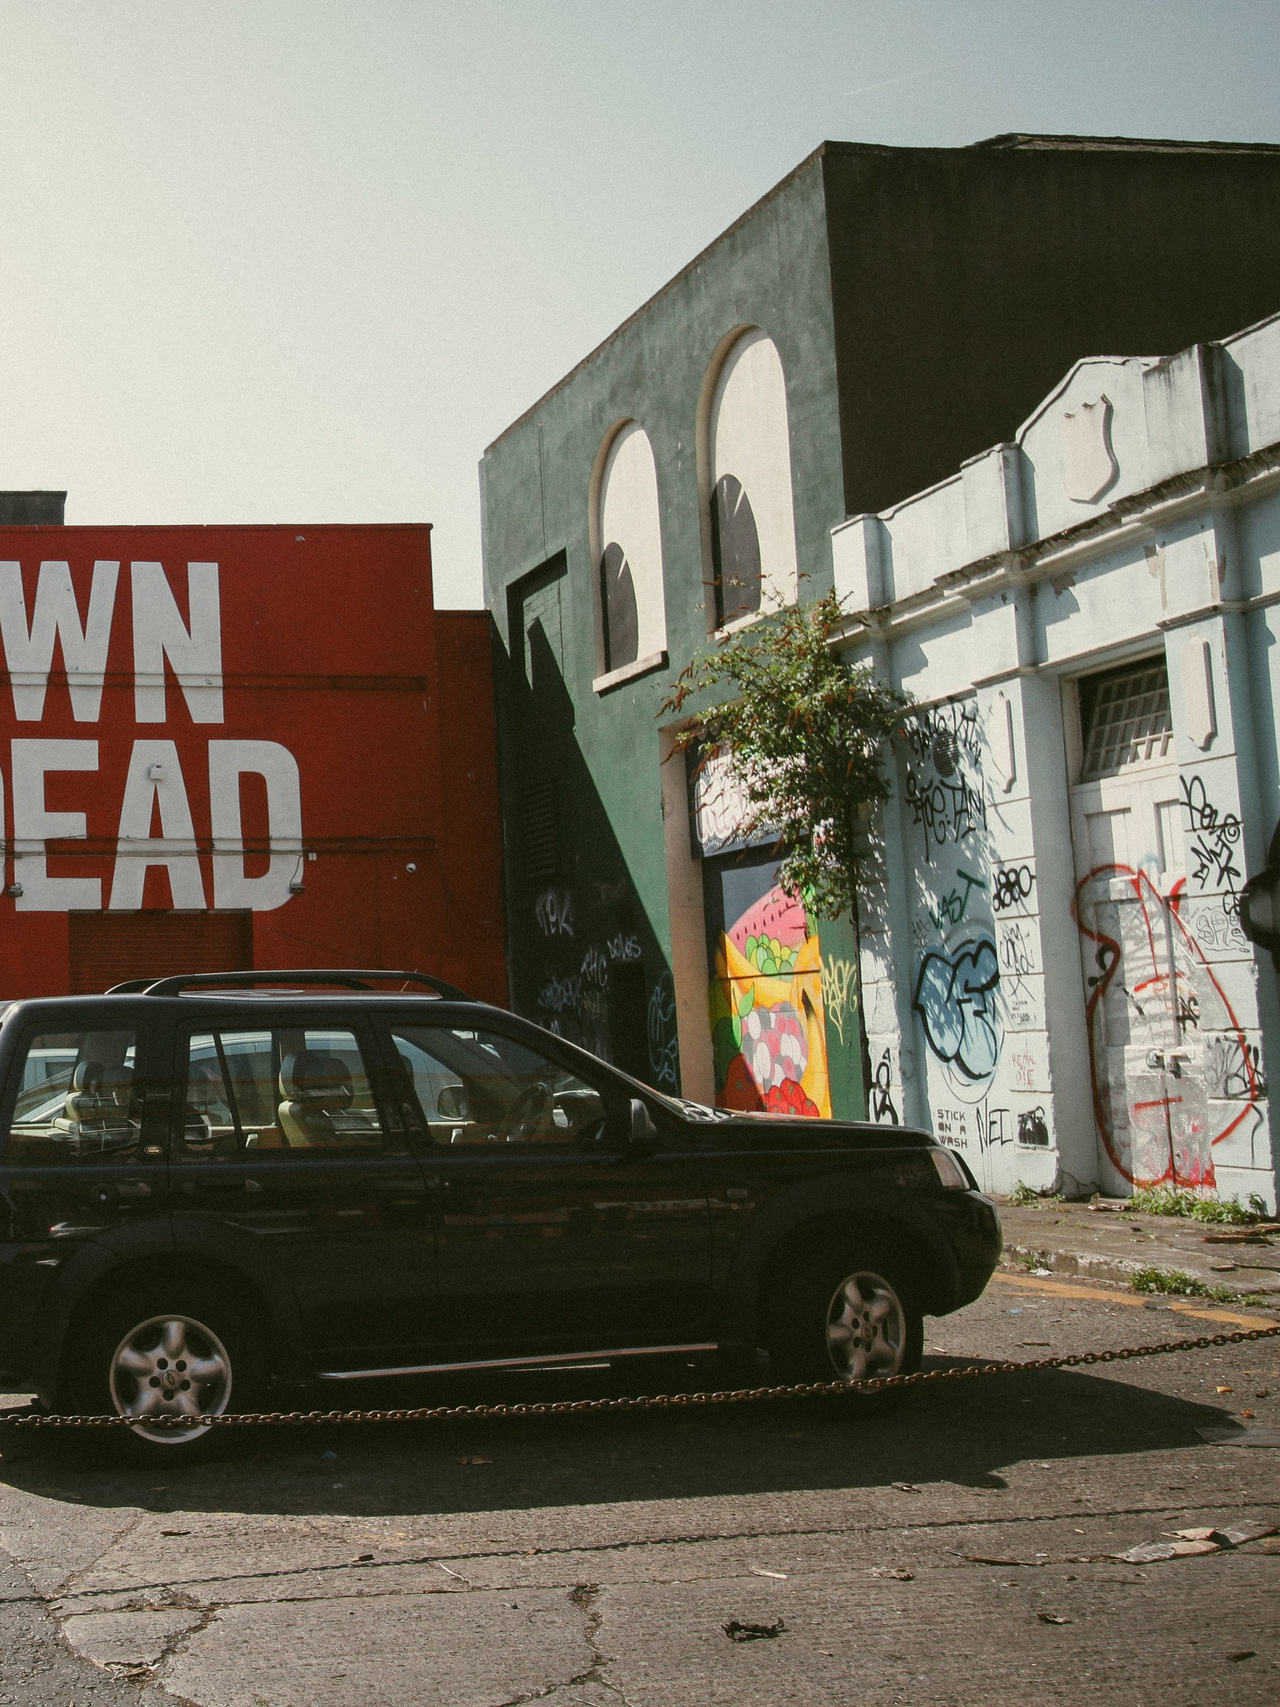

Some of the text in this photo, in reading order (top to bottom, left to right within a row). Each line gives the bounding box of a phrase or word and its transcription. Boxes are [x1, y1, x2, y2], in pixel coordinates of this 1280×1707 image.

[937, 1109, 966, 1122] STICK
[938, 1121, 967, 1135] ON A
[938, 1134, 968, 1149] WASH
